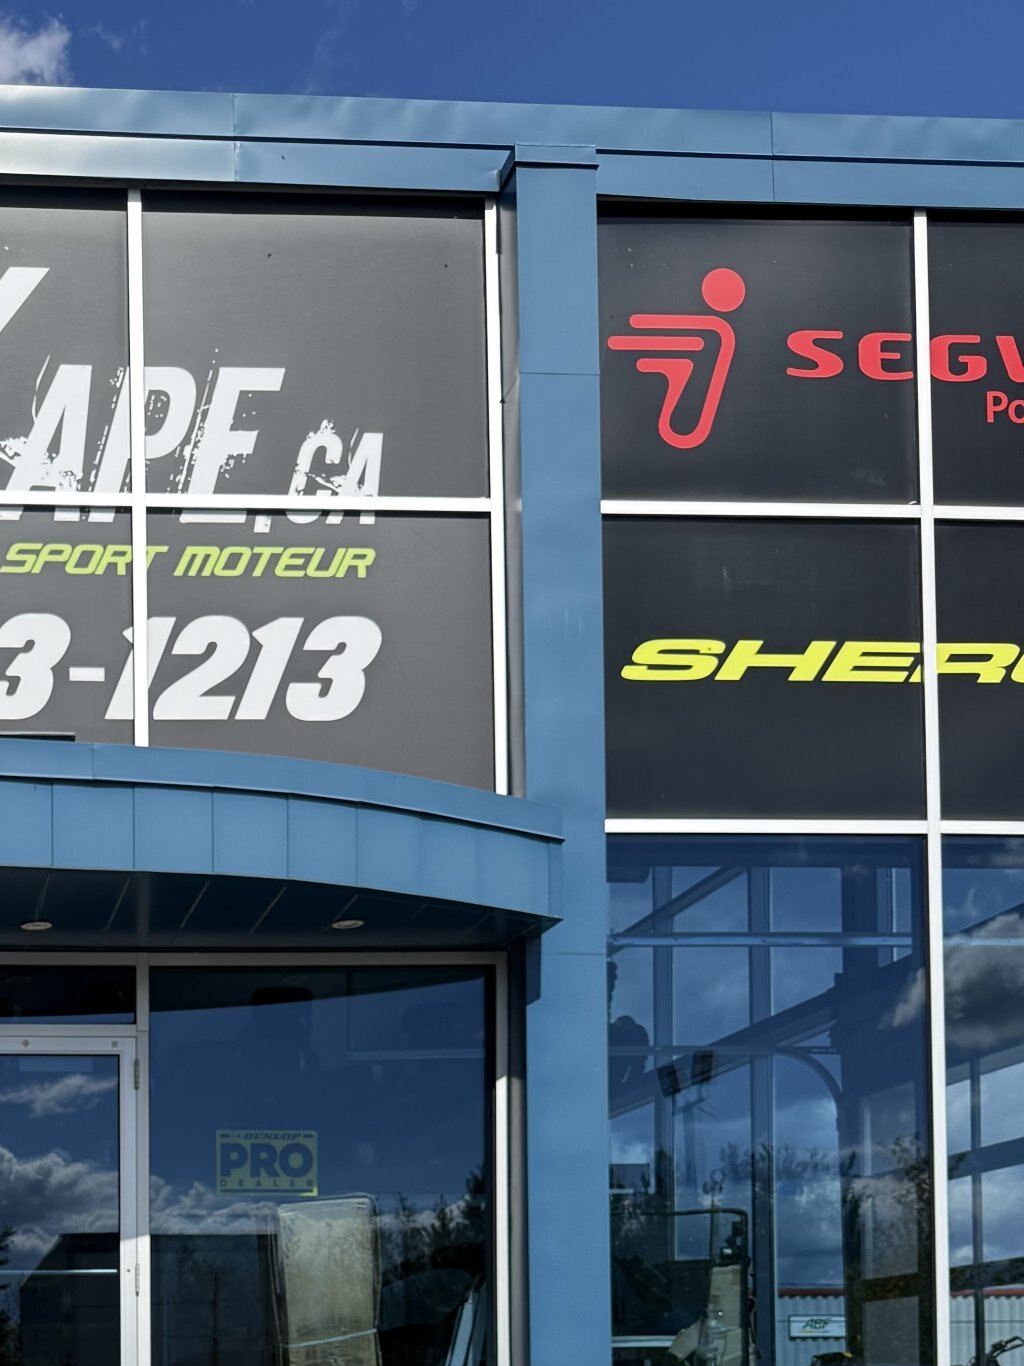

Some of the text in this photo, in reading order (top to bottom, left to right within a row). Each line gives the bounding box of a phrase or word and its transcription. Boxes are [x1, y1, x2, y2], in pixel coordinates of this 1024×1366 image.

[0, 543, 169, 576] SPORT
[173, 545, 376, 578] MOTEUR
[621, 639, 1024, 684] SHER
[220, 1142, 314, 1178] PRO
[219, 1179, 314, 1188] DEALER
